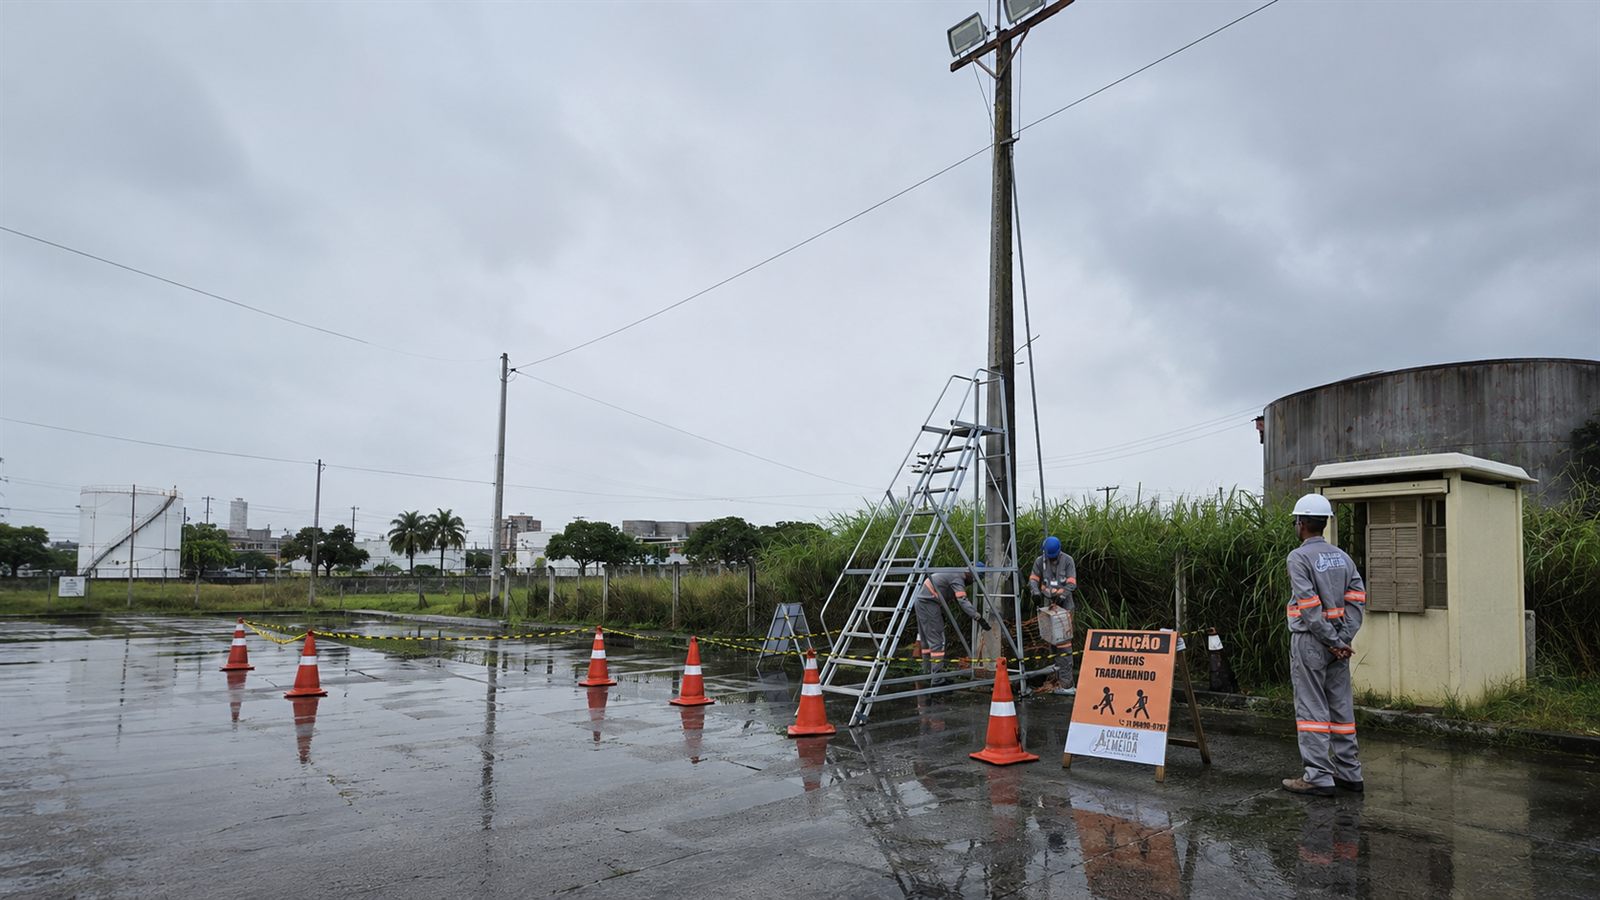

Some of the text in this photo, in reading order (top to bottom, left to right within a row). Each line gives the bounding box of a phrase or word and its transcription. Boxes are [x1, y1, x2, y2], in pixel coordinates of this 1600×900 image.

[1098, 634, 1161, 652] ATENÇÃO
[1108, 654, 1145, 666] HOMENS
[1095, 667, 1156, 682] TRABALHANDO
